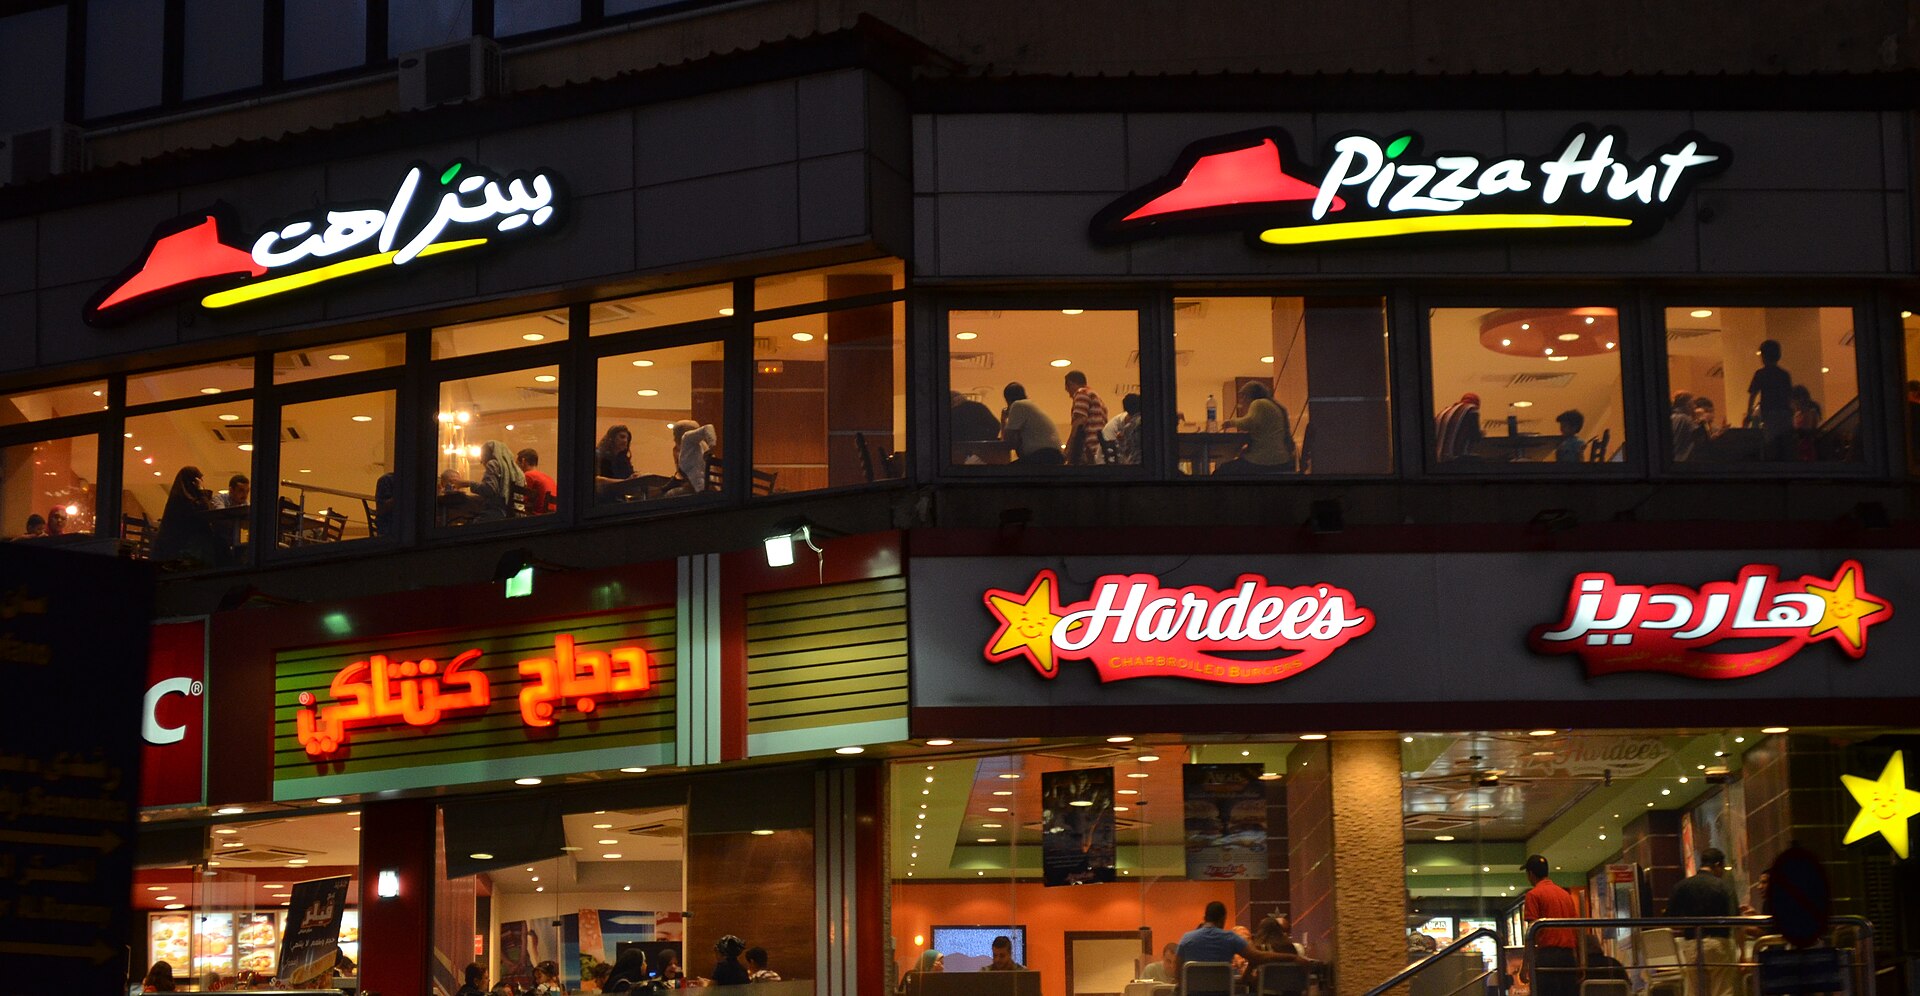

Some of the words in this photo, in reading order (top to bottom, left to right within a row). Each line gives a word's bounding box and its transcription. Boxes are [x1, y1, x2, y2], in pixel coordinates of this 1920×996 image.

[1312, 134, 1532, 220] Pizza
[1540, 131, 1720, 204] Hut
[1051, 581, 1366, 652] Hardee's
[1541, 574, 1827, 646] هارديز
[296, 648, 491, 756] كنتاكي
[518, 633, 651, 728] دجاج
